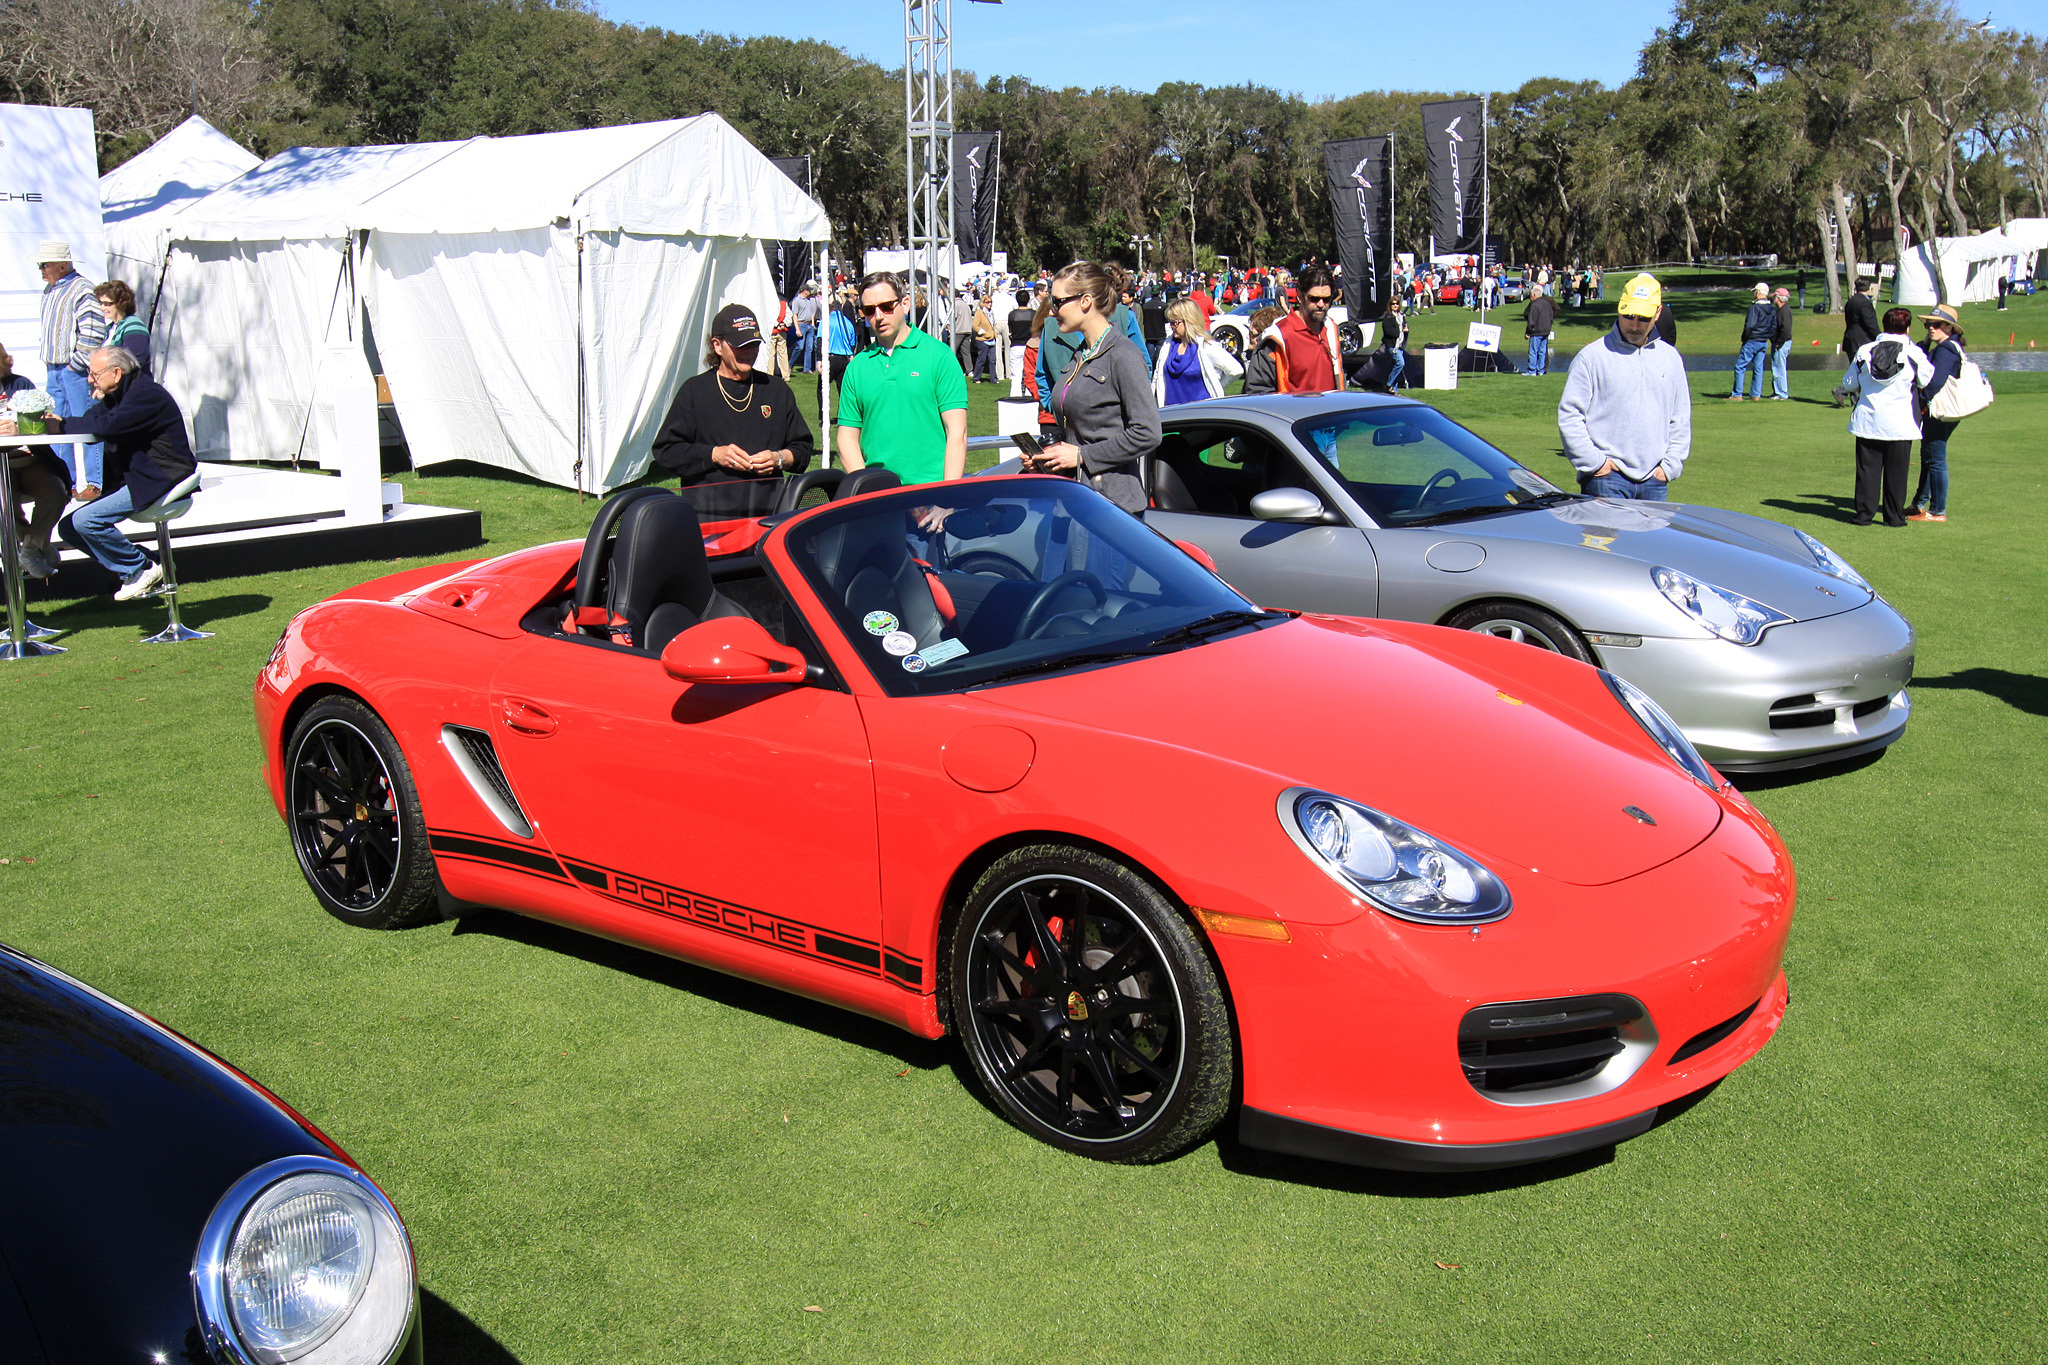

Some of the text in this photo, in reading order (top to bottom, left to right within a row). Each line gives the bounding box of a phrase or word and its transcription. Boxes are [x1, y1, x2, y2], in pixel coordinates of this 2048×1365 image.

[1449, 139, 1464, 238] CORVETTE
[1356, 186, 1377, 303] CORVETTE
[1472, 328, 1498, 339] CORVETTE
[614, 876, 807, 949] PORSCHE
